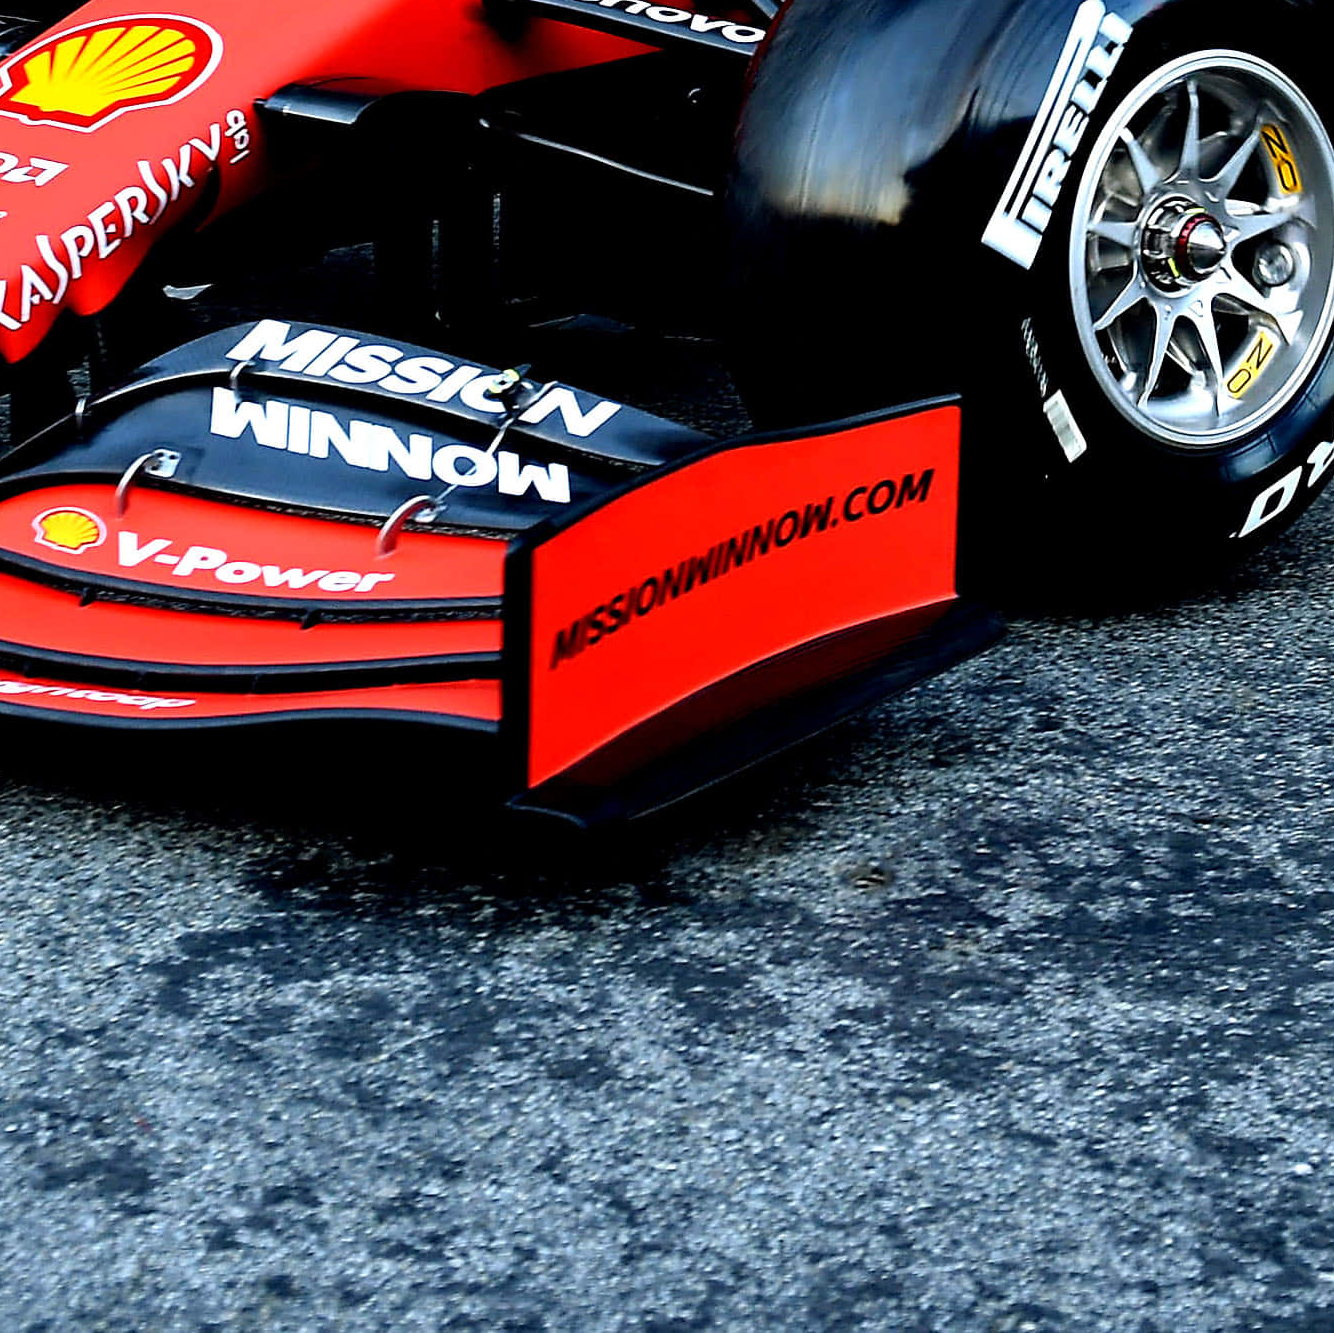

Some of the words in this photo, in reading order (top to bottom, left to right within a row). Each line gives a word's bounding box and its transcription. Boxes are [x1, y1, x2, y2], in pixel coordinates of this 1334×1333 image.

[226, 319, 622, 437] MISSION
[210, 386, 571, 503] WINNOW
[118, 530, 395, 593] V-Power
[549, 468, 935, 671] MISSIONWINNOW.COM
